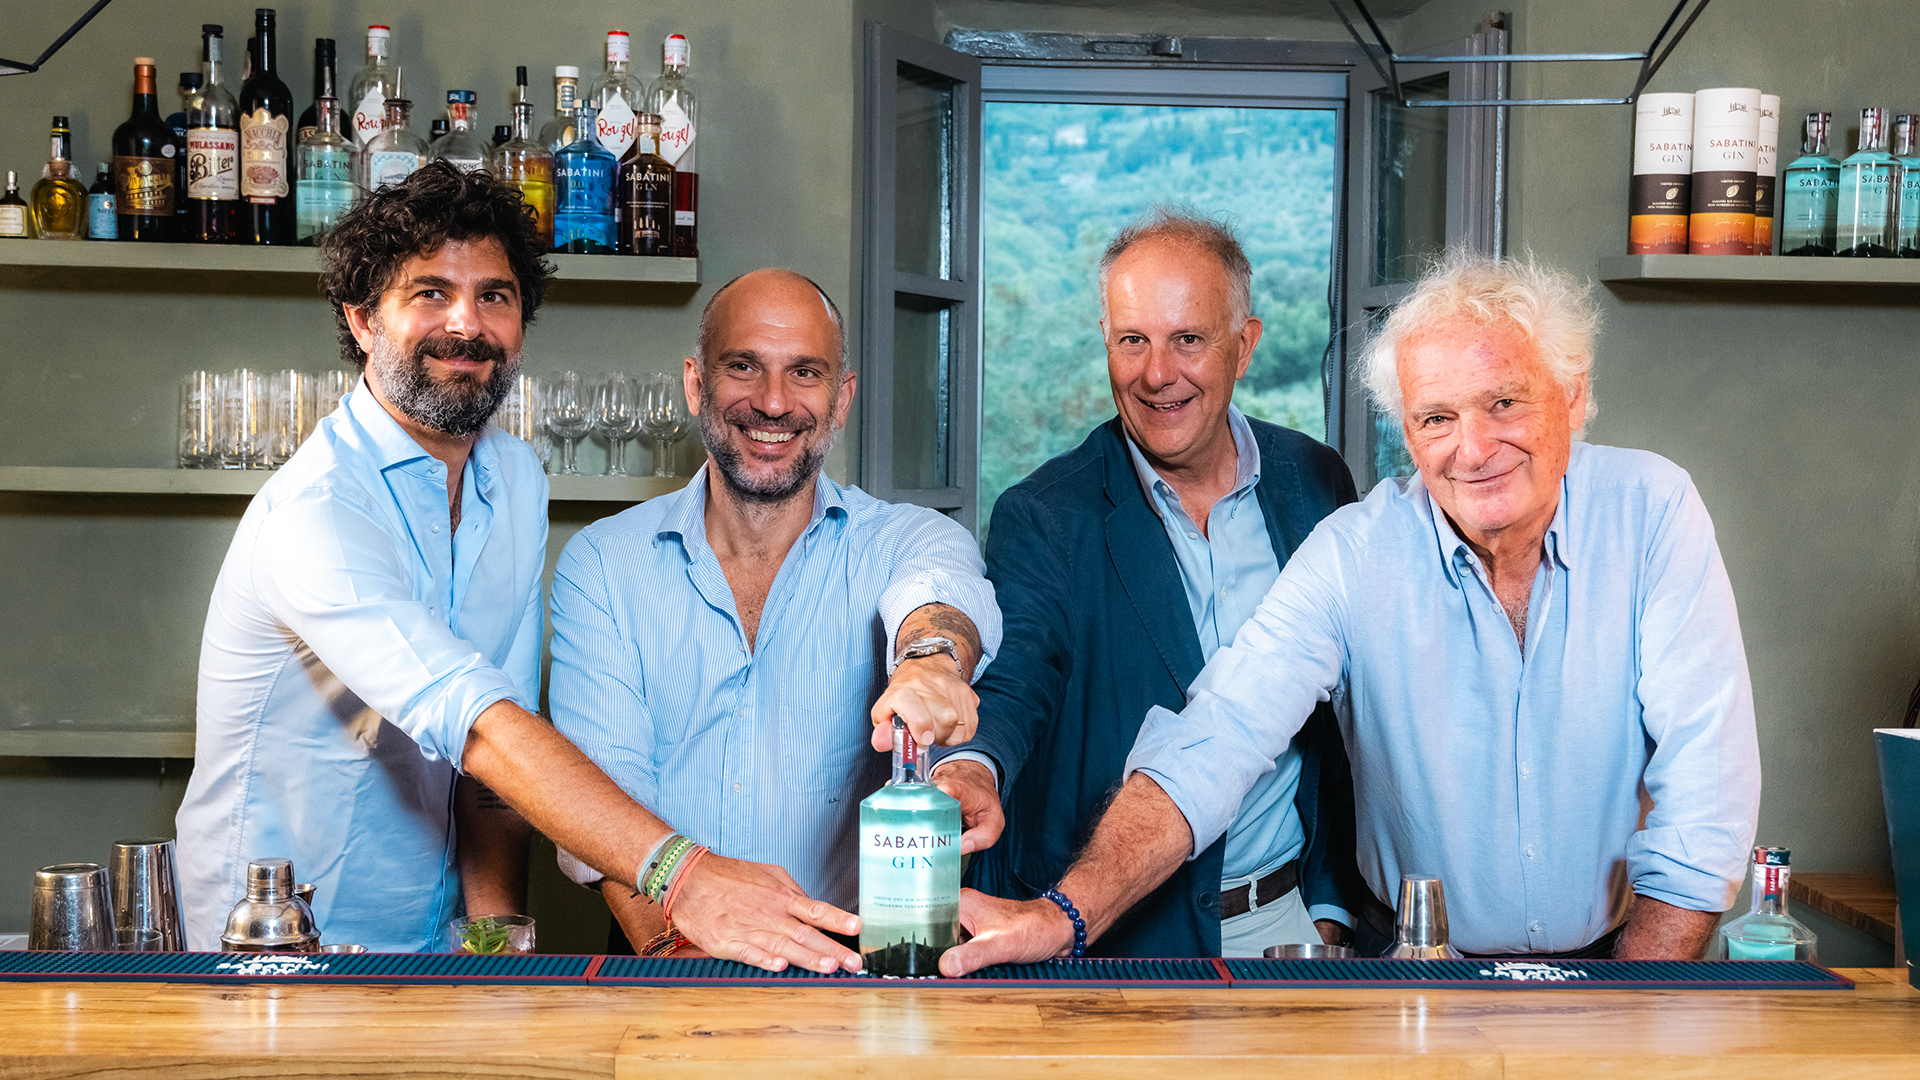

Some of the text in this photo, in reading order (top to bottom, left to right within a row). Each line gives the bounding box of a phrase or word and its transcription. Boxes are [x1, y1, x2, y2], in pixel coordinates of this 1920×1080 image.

[598, 118, 635, 143] Rouge!
[660, 123, 690, 148] ouge!
[190, 141, 235, 151] MULASSANO
[1650, 143, 1692, 152] SABATIN
[1710, 140, 1756, 149] SABATINI
[1663, 154, 1684, 163] GIN
[1723, 151, 1745, 160] GIN
[1759, 154, 1769, 164] IN
[190, 153, 234, 181] Bitter
[305, 160, 352, 170] SABATINI
[557, 167, 604, 178] SABATINI
[625, 173, 670, 182] SABATINI
[636, 182, 658, 191] GIN
[874, 834, 952, 849] SABATINI
[892, 855, 934, 869] GIN
